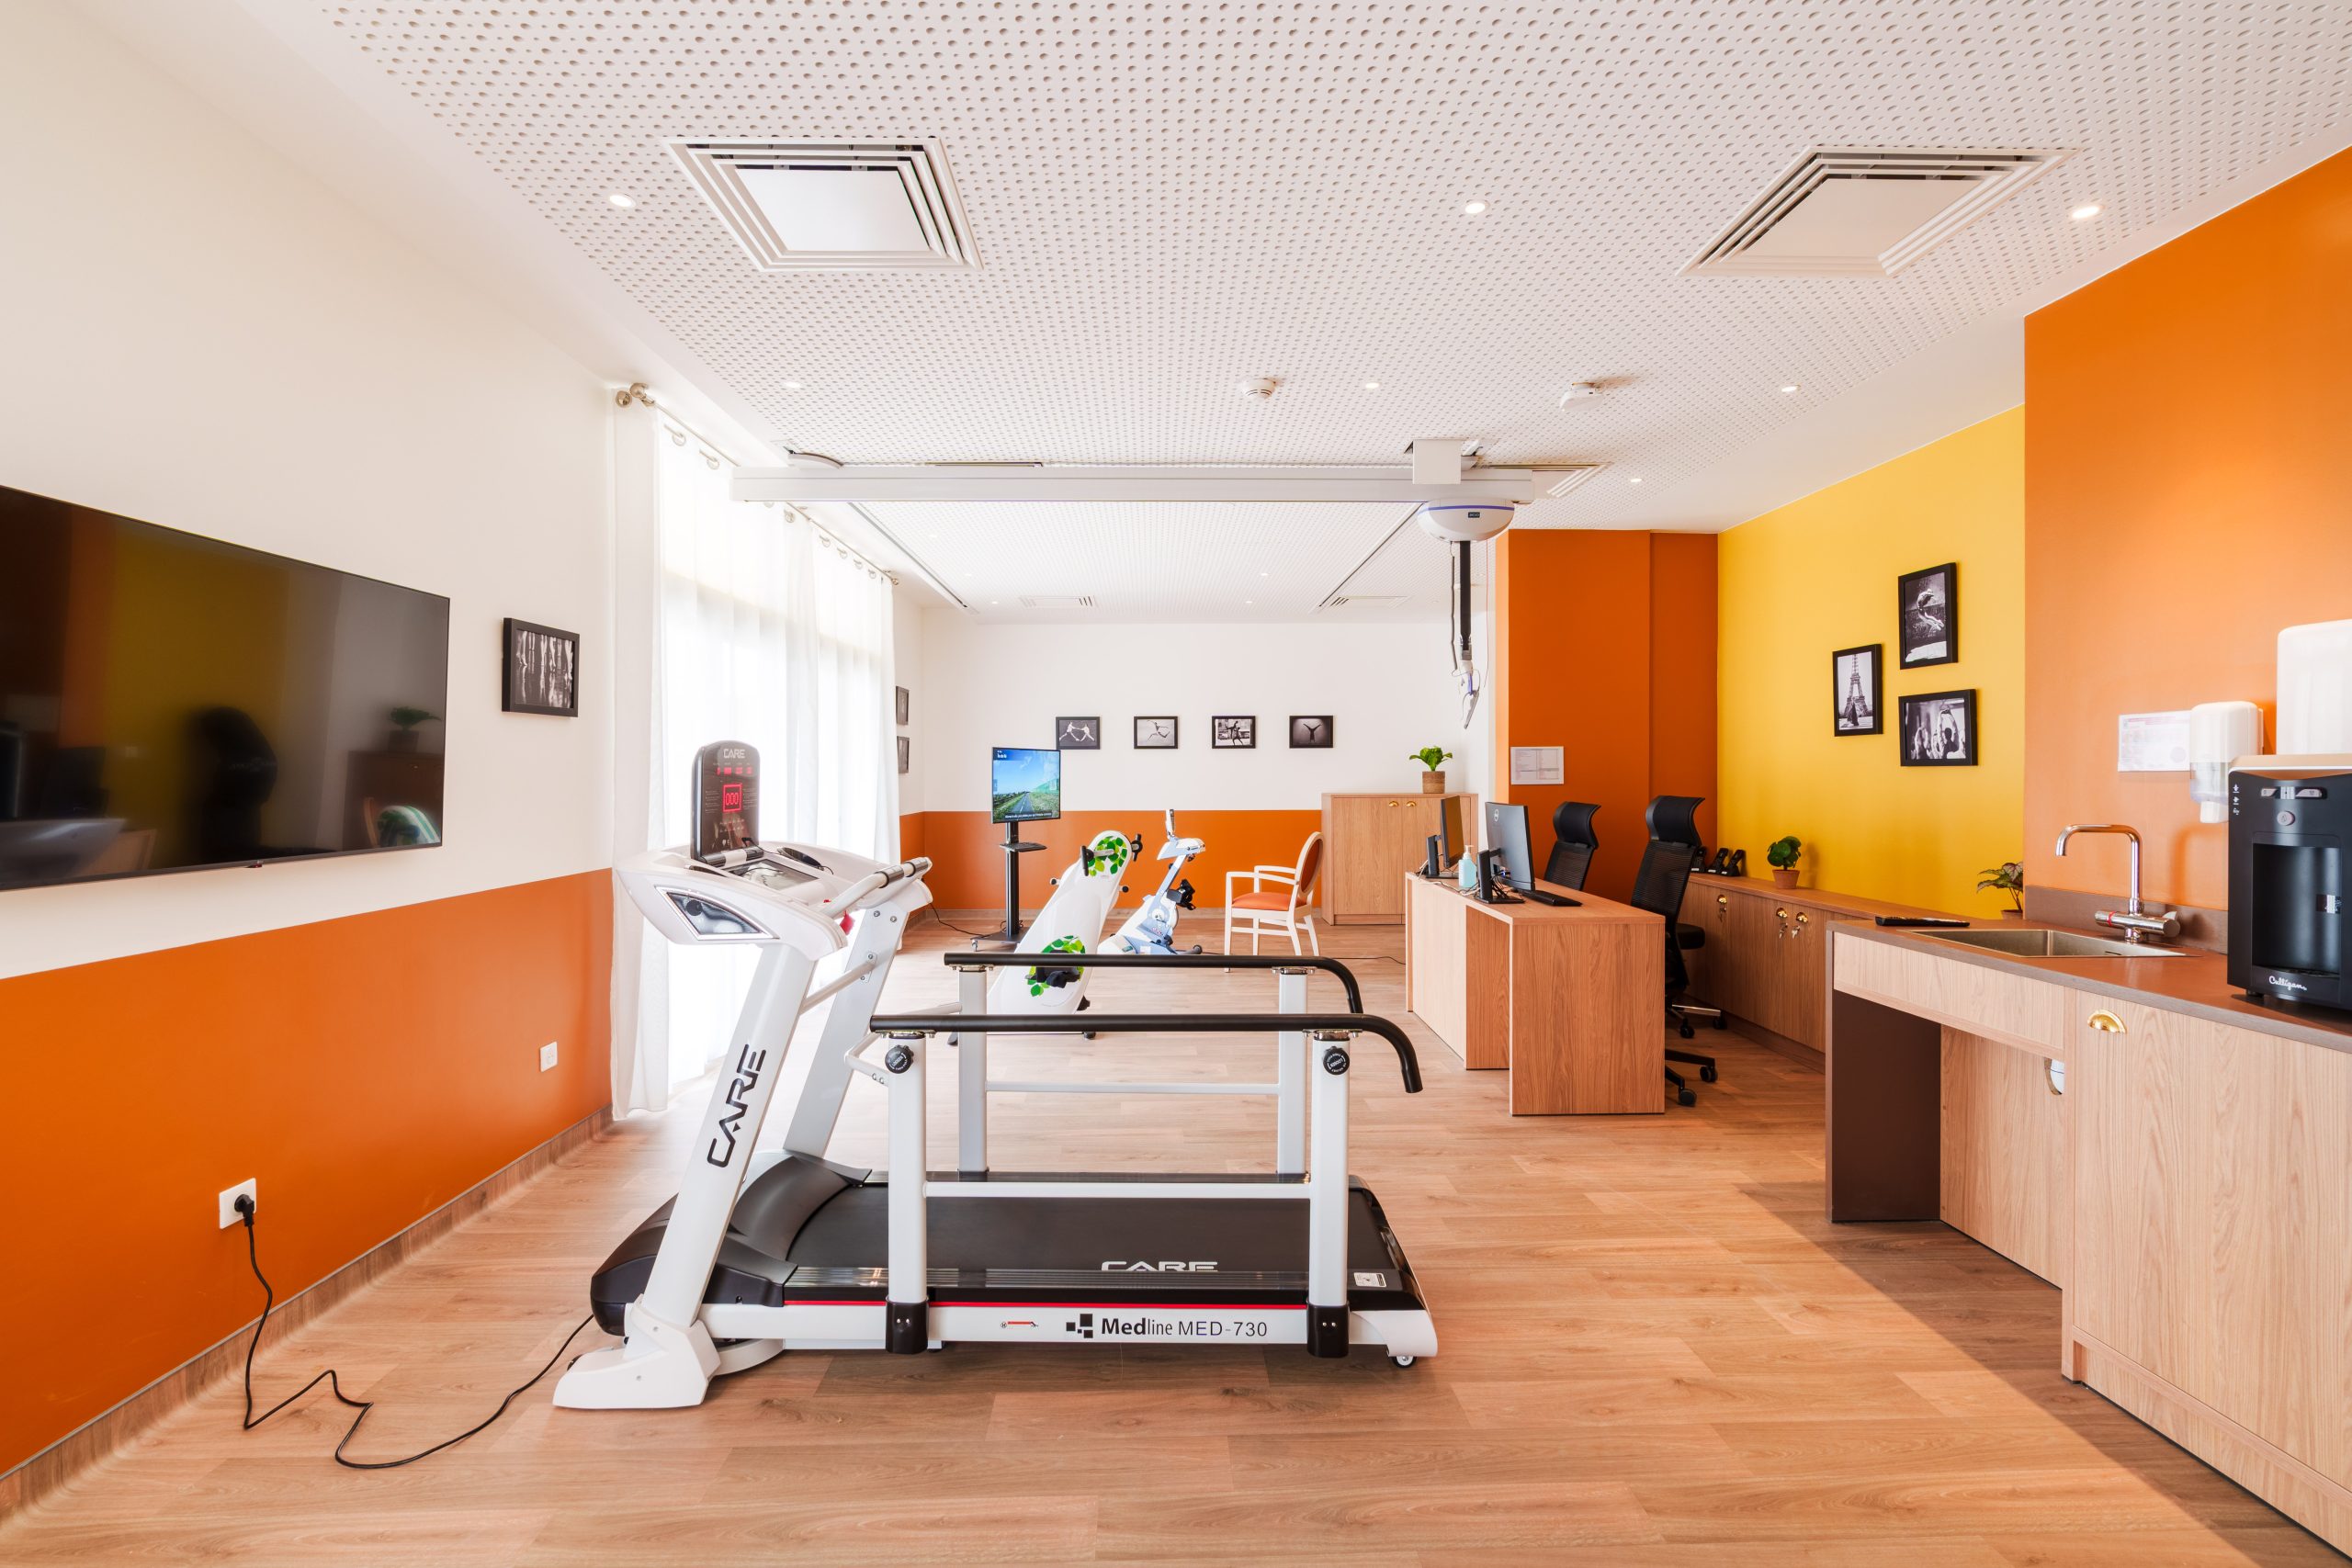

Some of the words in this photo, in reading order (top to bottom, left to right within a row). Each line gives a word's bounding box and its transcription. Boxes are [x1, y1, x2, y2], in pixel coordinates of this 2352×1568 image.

[723, 748, 746, 759] CARE
[2268, 975, 2308, 991] Culligan
[707, 1043, 767, 1168] CARE
[1101, 1260, 1218, 1272] CARE
[1102, 1317, 1173, 1336] Medline
[1178, 1321, 1268, 1337] MED-730
